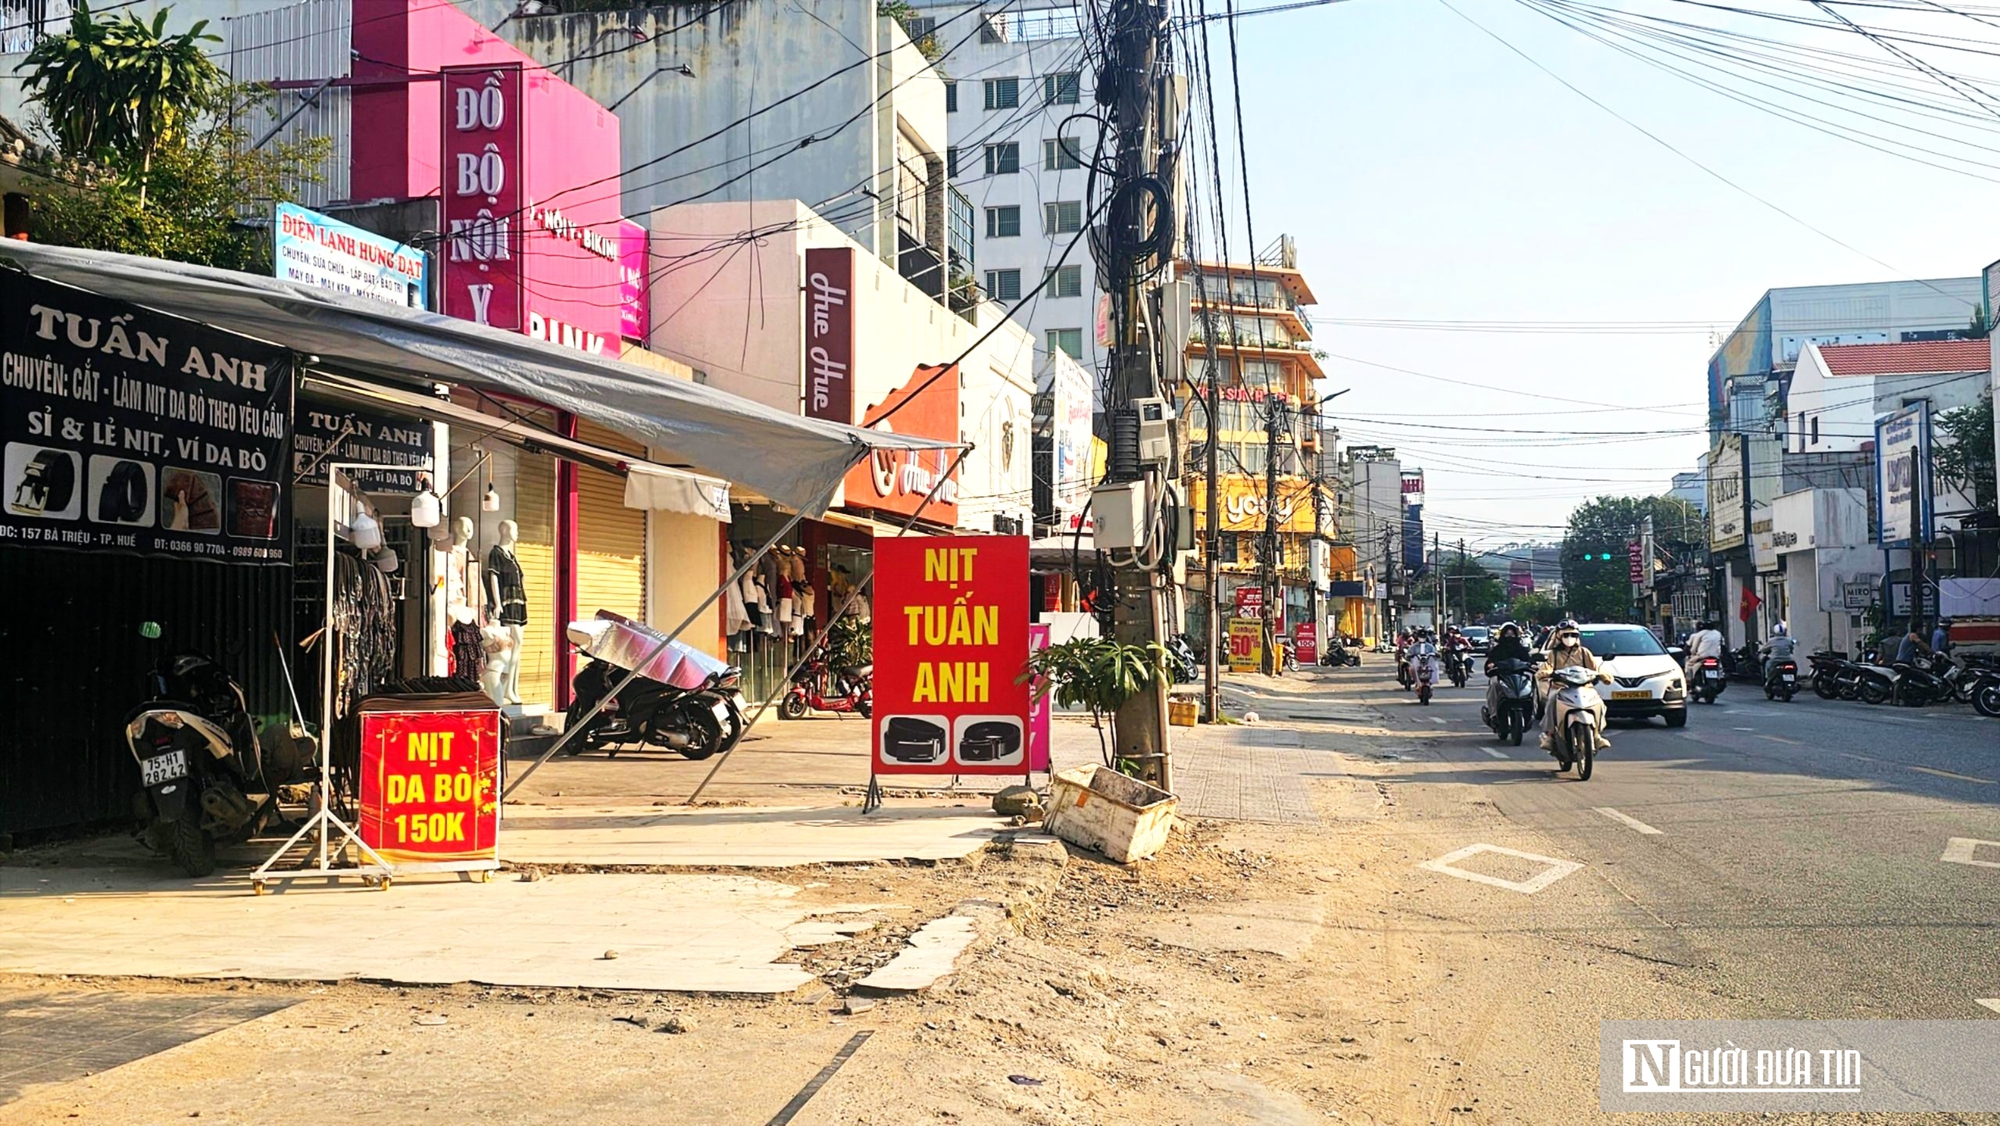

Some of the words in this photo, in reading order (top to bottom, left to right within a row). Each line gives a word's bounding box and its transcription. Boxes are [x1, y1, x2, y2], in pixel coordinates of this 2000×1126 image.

[456, 70, 505, 130] ĐỒ
[457, 143, 505, 204] BỘ
[282, 214, 316, 243] ĐIỆN
[320, 228, 356, 253] LẠNH
[359, 241, 395, 269] HƯNG
[397, 257, 423, 279] ĐẠT
[450, 209, 510, 271] NỘI
[583, 228, 618, 261] BIKINI
[467, 283, 493, 326] Y
[810, 272, 847, 338] Hue
[30, 303, 169, 367] TUẤN
[181, 346, 267, 392] ANH
[3, 351, 68, 397] CHUYÊN:
[73, 358, 100, 402] CẮT
[113, 371, 142, 411] LÀM
[146, 382, 166, 421] NỊT
[169, 389, 186, 420] DA
[189, 388, 205, 424] BÒ
[208, 398, 236, 431] THEO
[239, 401, 259, 435] YÊU
[262, 402, 284, 439] CẦU
[810, 346, 847, 412] Hue
[28, 405, 52, 437] SỈ
[61, 417, 84, 441] &
[93, 416, 117, 446] LẺ
[124, 427, 170, 457] NỊT,
[177, 436, 199, 461] VÍ
[206, 443, 233, 467] DA
[239, 447, 267, 472] BÒ
[308, 412, 373, 438] TUẤN
[378, 426, 423, 447] ANH
[386, 472, 398, 485] DA
[400, 472, 412, 486] BÒ
[21, 528, 41, 540] 157
[44, 527, 59, 541] BÀ
[62, 528, 90, 545] TRIỆU
[100, 533, 115, 545] TP.
[117, 533, 136, 547] HUẾ
[154, 538, 168, 550] ĐT:
[170, 540, 192, 552] 0366
[194, 543, 204, 553] 90
[206, 543, 225, 555] 7704
[232, 546, 252, 557] 0989
[268, 549, 282, 559] 960
[925, 548, 977, 589] NỊT
[1847, 588, 1869, 596] MIRO
[904, 591, 999, 645] TUẤN
[912, 662, 989, 702] ANH
[148, 752, 178, 770] 75-H1
[408, 732, 455, 767] NỊT
[145, 764, 185, 785] 282.42
[387, 774, 426, 804] DA
[434, 766, 472, 803] BÒ
[394, 812, 466, 843] 150K
